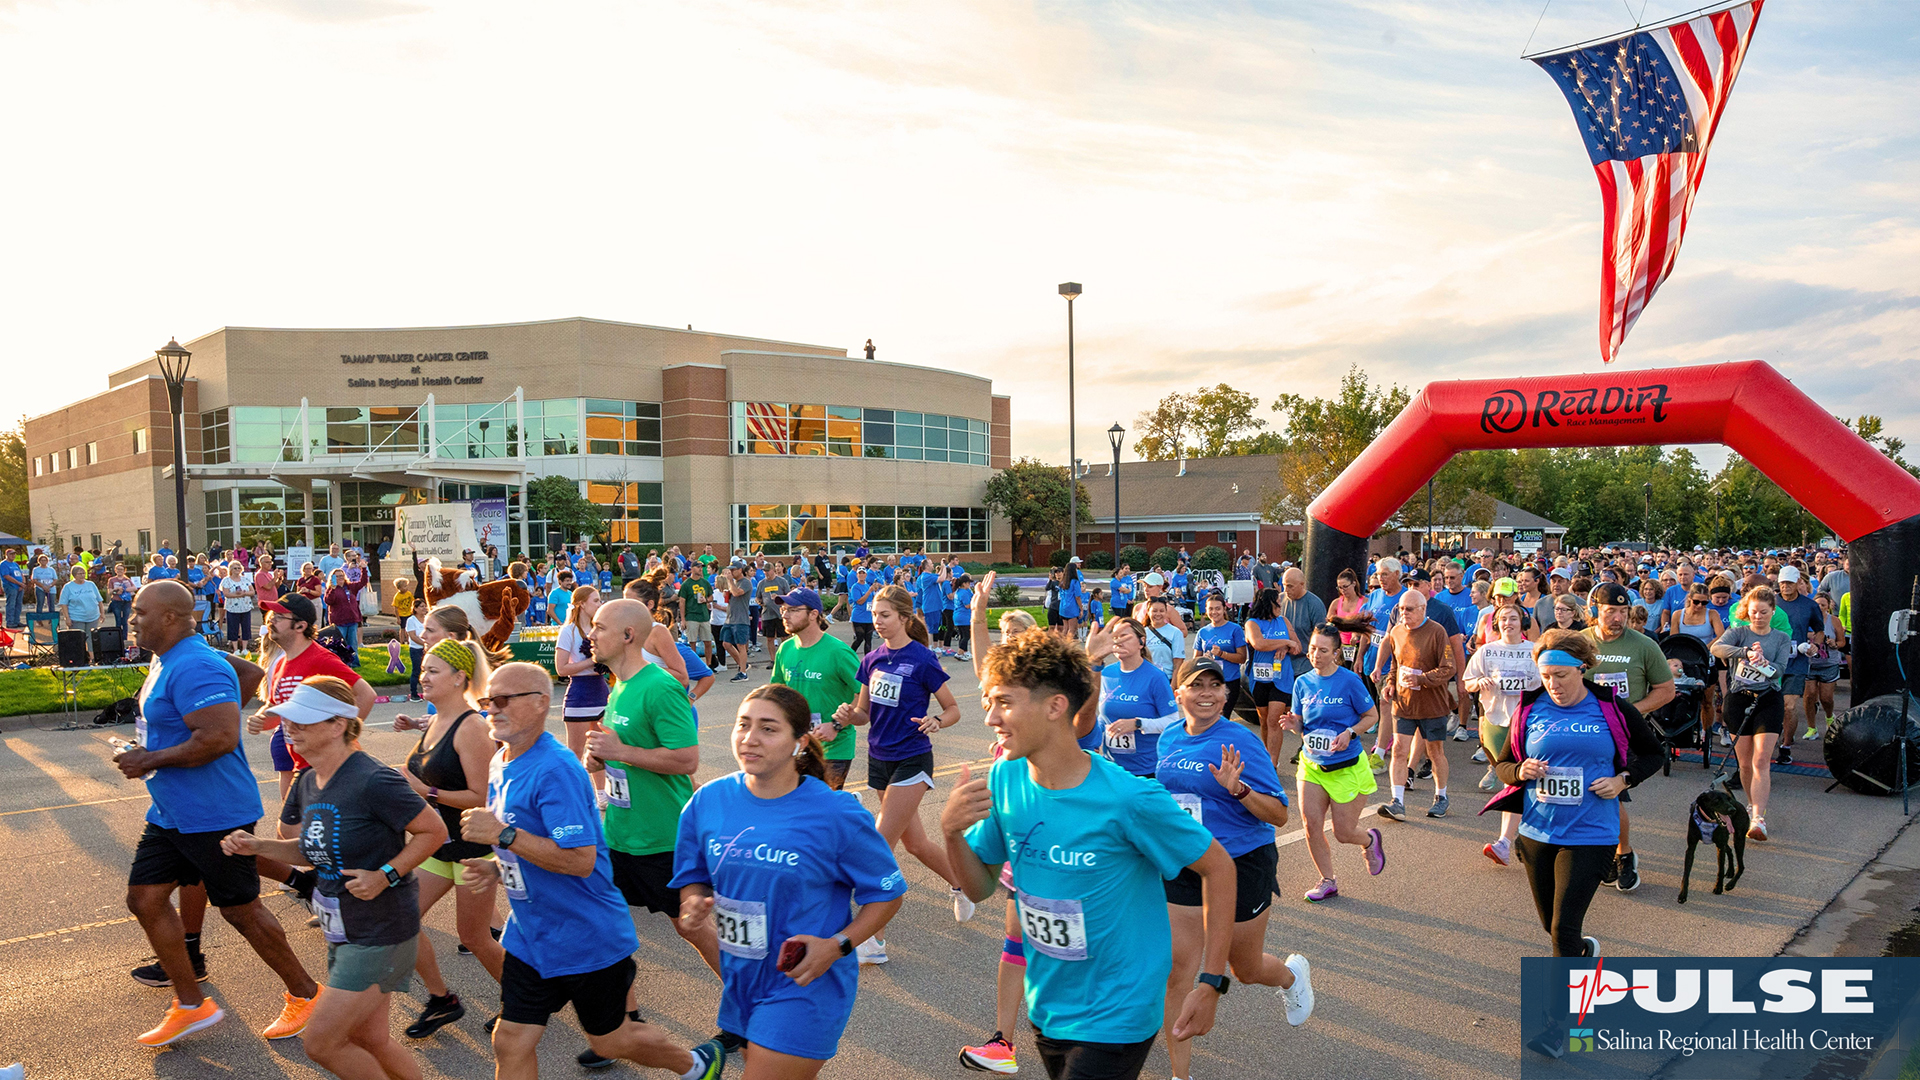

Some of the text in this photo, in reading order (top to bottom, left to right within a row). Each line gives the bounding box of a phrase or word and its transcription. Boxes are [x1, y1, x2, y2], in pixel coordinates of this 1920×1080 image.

[341, 351, 489, 364] TAMMY WALKER CANCER CENTER
[411, 366, 421, 374] at
[348, 376, 484, 389] Salina Regional Health Center
[1566, 416, 1646, 427] Race Management
[376, 510, 393, 519] 511
[483, 509, 502, 518] Cure
[408, 515, 452, 532] Tammy Walker
[408, 530, 450, 543] Cancer Center
[1372, 633, 1384, 644] 70
[804, 669, 822, 680] Cure
[1256, 668, 1270, 678] 966
[1741, 667, 1762, 682] 672
[870, 681, 897, 700] 1281
[1500, 678, 1526, 690] 1221
[1120, 692, 1139, 702] Cure
[1323, 696, 1343, 704] Cure
[1570, 722, 1600, 733] Cure
[1309, 736, 1330, 750] 560
[1177, 758, 1205, 772] Cure
[1539, 777, 1581, 797] 1058
[744, 849, 753, 859] a
[754, 843, 800, 867] Cure
[1040, 851, 1047, 861] a
[1050, 845, 1097, 867] Cure
[717, 913, 751, 946] 531
[1025, 911, 1070, 947] 533
